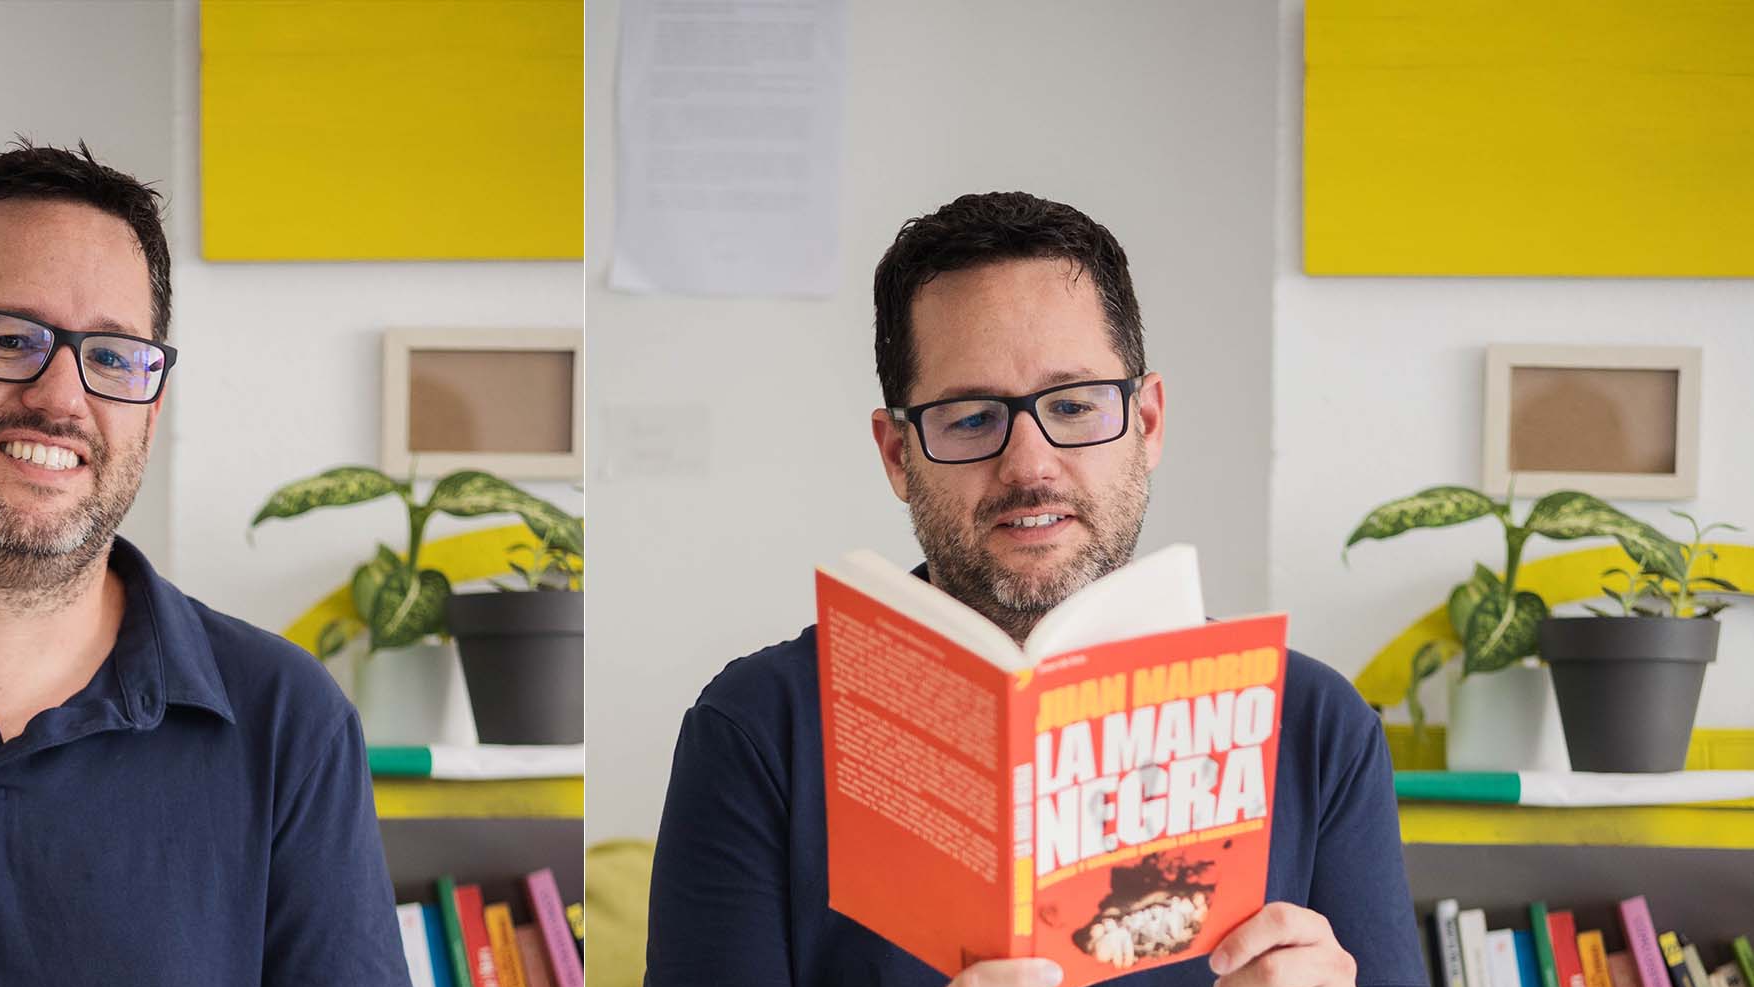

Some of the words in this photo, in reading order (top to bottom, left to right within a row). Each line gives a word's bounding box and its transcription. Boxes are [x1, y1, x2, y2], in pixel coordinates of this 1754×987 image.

[1035, 720, 1097, 796] LA
[1101, 685, 1276, 778] MANO
[1036, 673, 1127, 733] JUAN
[1132, 647, 1280, 709] MADRID
[1036, 745, 1268, 878] NEGRA
